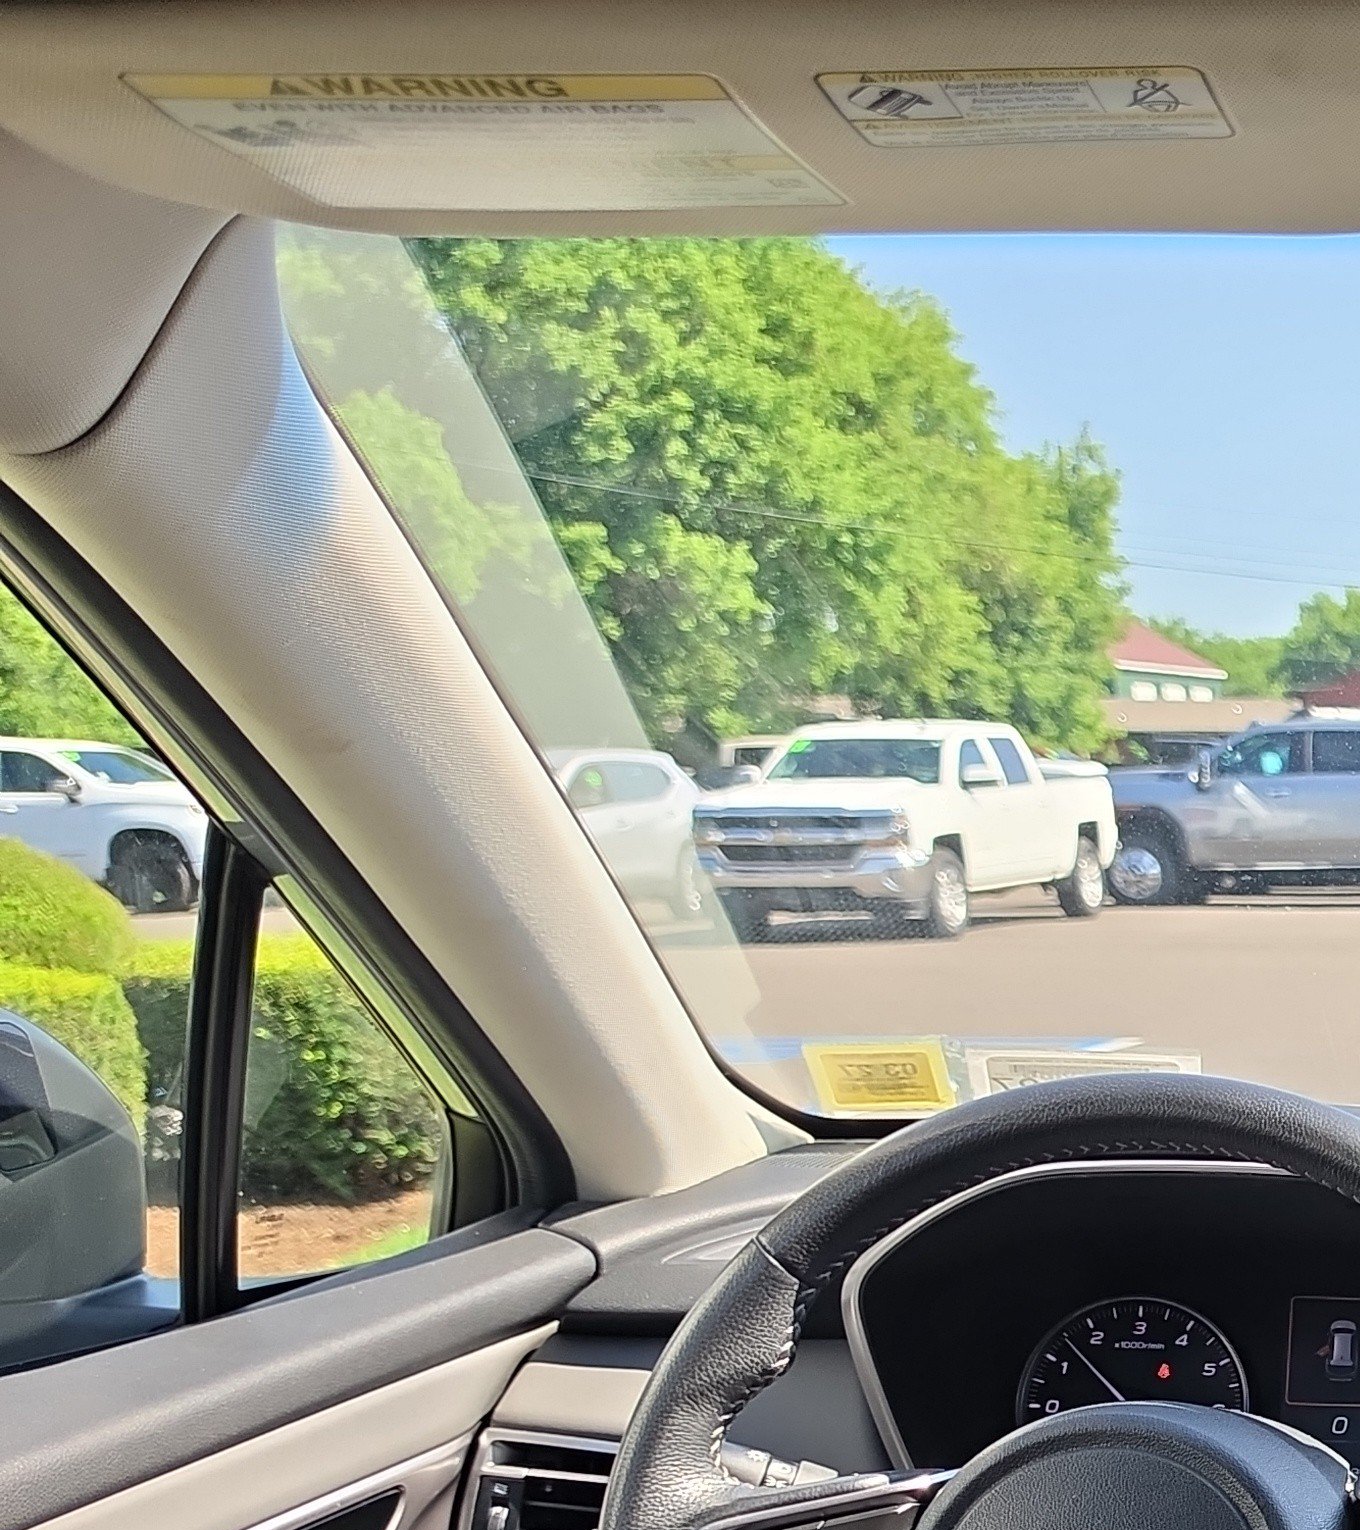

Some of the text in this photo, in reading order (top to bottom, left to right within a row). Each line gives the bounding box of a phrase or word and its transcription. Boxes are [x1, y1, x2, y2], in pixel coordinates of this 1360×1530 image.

[300, 78, 571, 98] WARNING
[1132, 1322, 1147, 1335] 3
[1090, 1331, 1104, 1345] 2
[1175, 1334, 1189, 1346] 4
[1061, 1361, 1069, 1375] 1
[1202, 1363, 1217, 1376] 5
[1045, 1399, 1060, 1414] 0
[1331, 1416, 1348, 1435] 0
